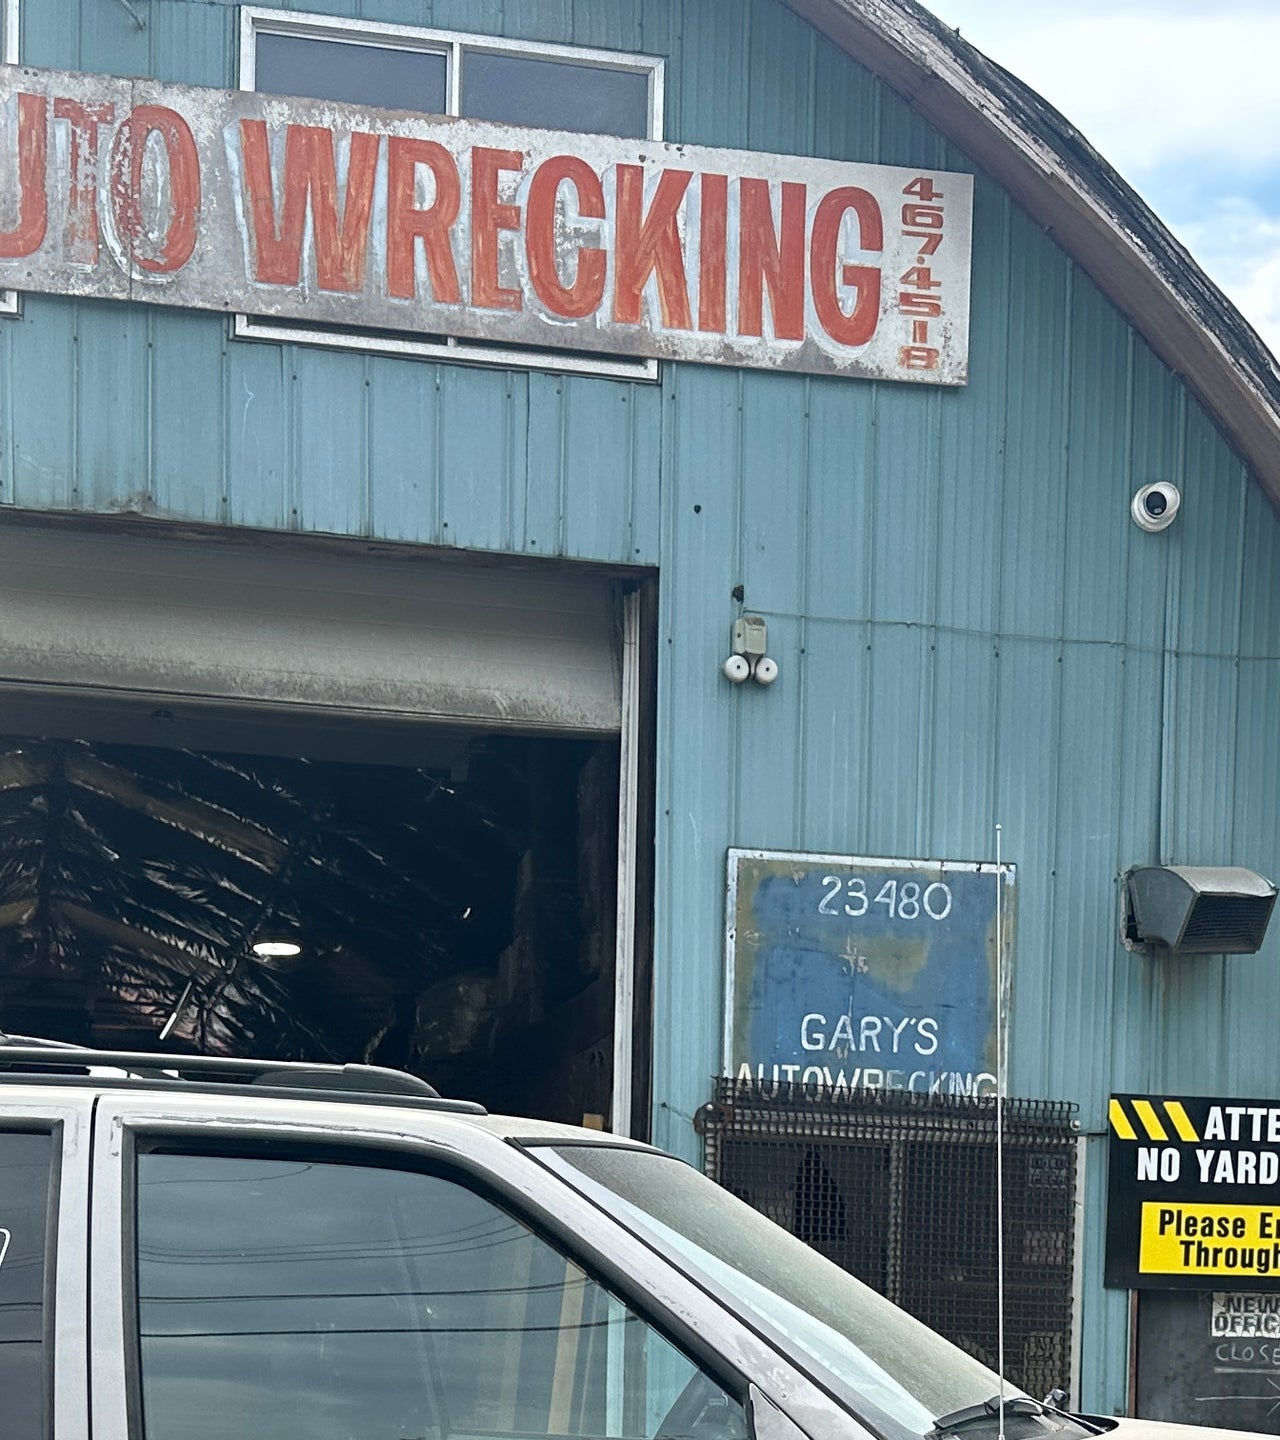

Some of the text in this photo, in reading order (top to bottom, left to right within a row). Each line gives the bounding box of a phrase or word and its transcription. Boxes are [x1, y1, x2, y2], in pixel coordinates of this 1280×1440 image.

[238, 118, 884, 348] WRECKING
[818, 875, 952, 920] 23480
[801, 1013, 939, 1055] GARY'S
[1137, 1147, 1180, 1182] NO
[1195, 1149, 1279, 1186] YARD
[1158, 1209, 1246, 1238] Please
[1226, 1296, 1279, 1314] NEW
